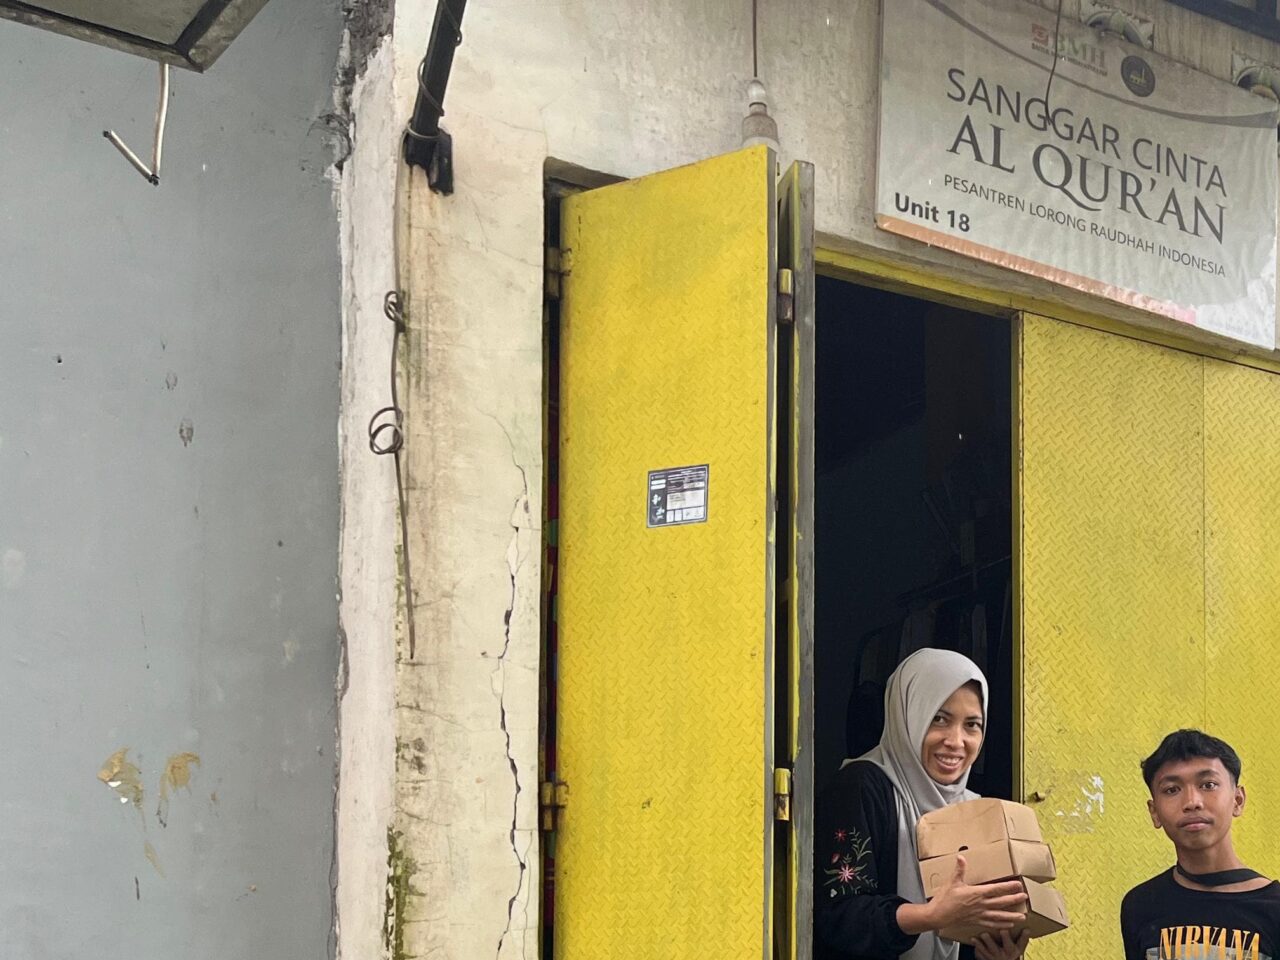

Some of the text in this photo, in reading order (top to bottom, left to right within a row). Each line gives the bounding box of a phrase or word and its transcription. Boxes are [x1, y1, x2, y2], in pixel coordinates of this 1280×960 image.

[946, 114, 1227, 245] AL QUR'AN
[947, 68, 1227, 197] SANGGAR CINTA
[895, 192, 970, 232] Unit 18
[944, 174, 1226, 277] PESANTREN LORONG RAUDHAH INDONESIA
